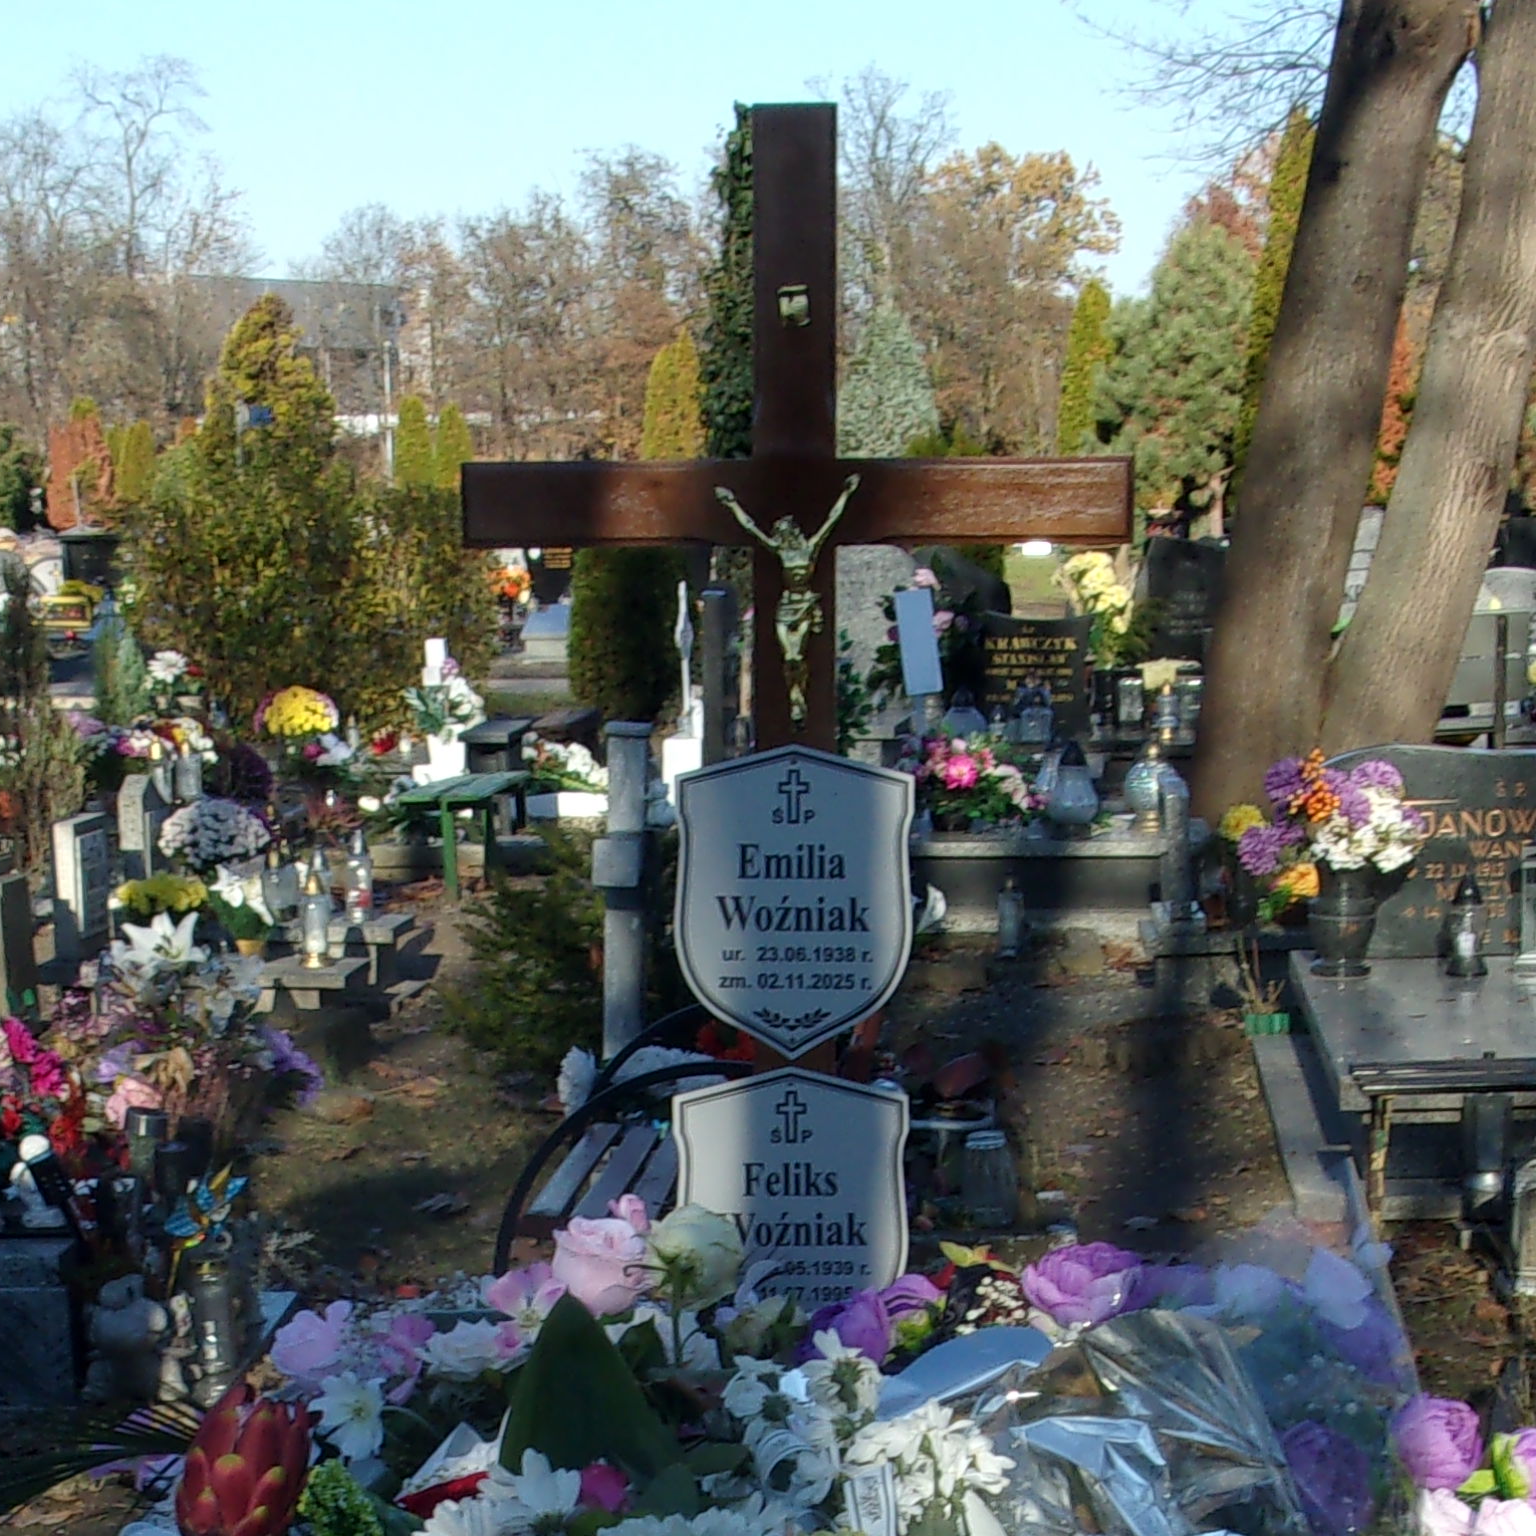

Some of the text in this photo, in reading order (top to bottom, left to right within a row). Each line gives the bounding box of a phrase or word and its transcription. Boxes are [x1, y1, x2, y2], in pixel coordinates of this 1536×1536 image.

[737, 843, 847, 881] Emilia
[717, 896, 871, 934] Woźniak
[722, 946, 874, 963] ur. 23.06.1938 r.
[718, 973, 873, 991] zm. 02.11.2025 r.
[742, 1161, 839, 1198] Feliks
